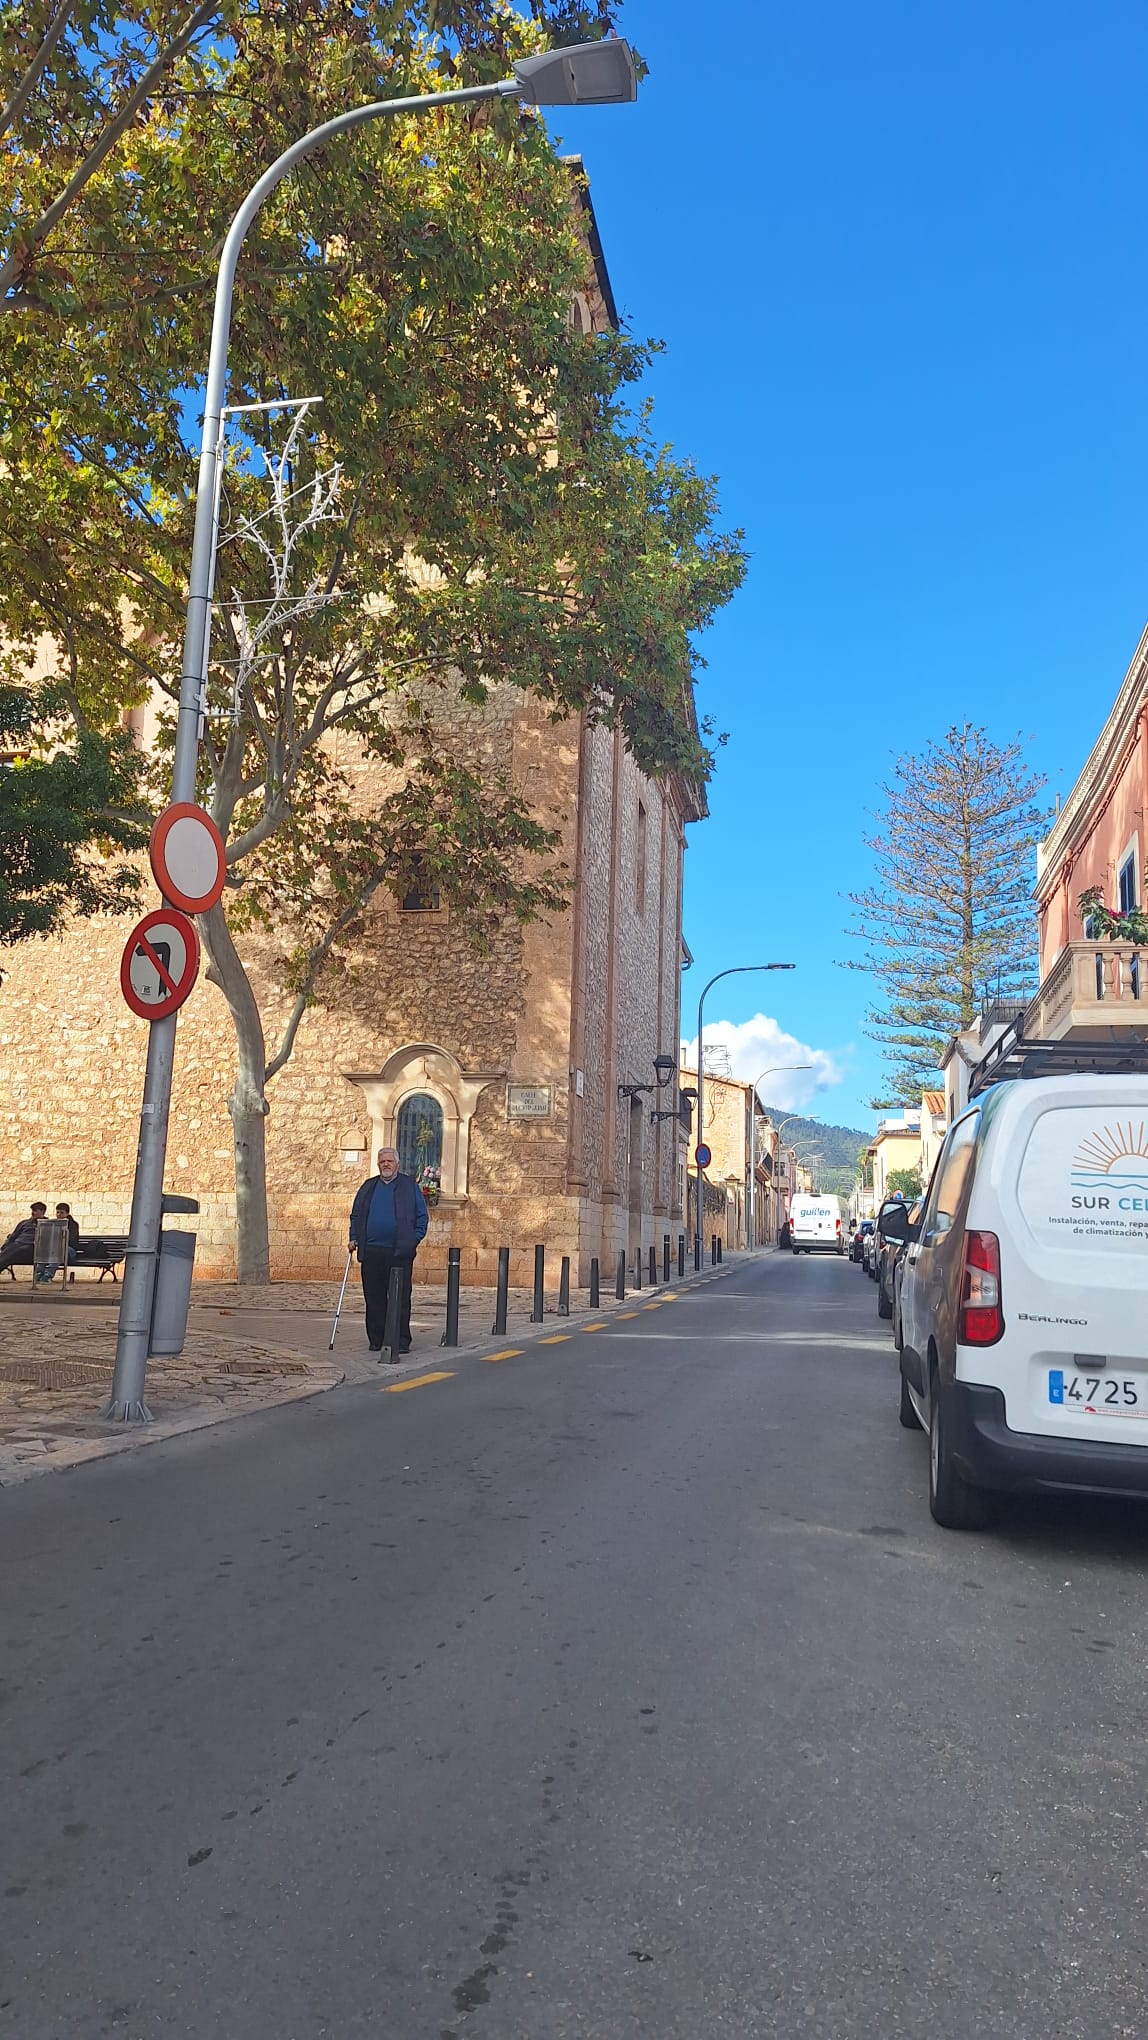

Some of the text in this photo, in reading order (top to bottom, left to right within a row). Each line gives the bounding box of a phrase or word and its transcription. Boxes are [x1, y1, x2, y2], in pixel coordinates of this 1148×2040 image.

[1071, 1196, 1110, 1209] SUR
[1049, 1216, 1098, 1226] Instalación,
[1100, 1219, 1127, 1228] venta,
[1085, 1227, 1143, 1237] climatización
[1068, 1377, 1138, 1405] 4725
